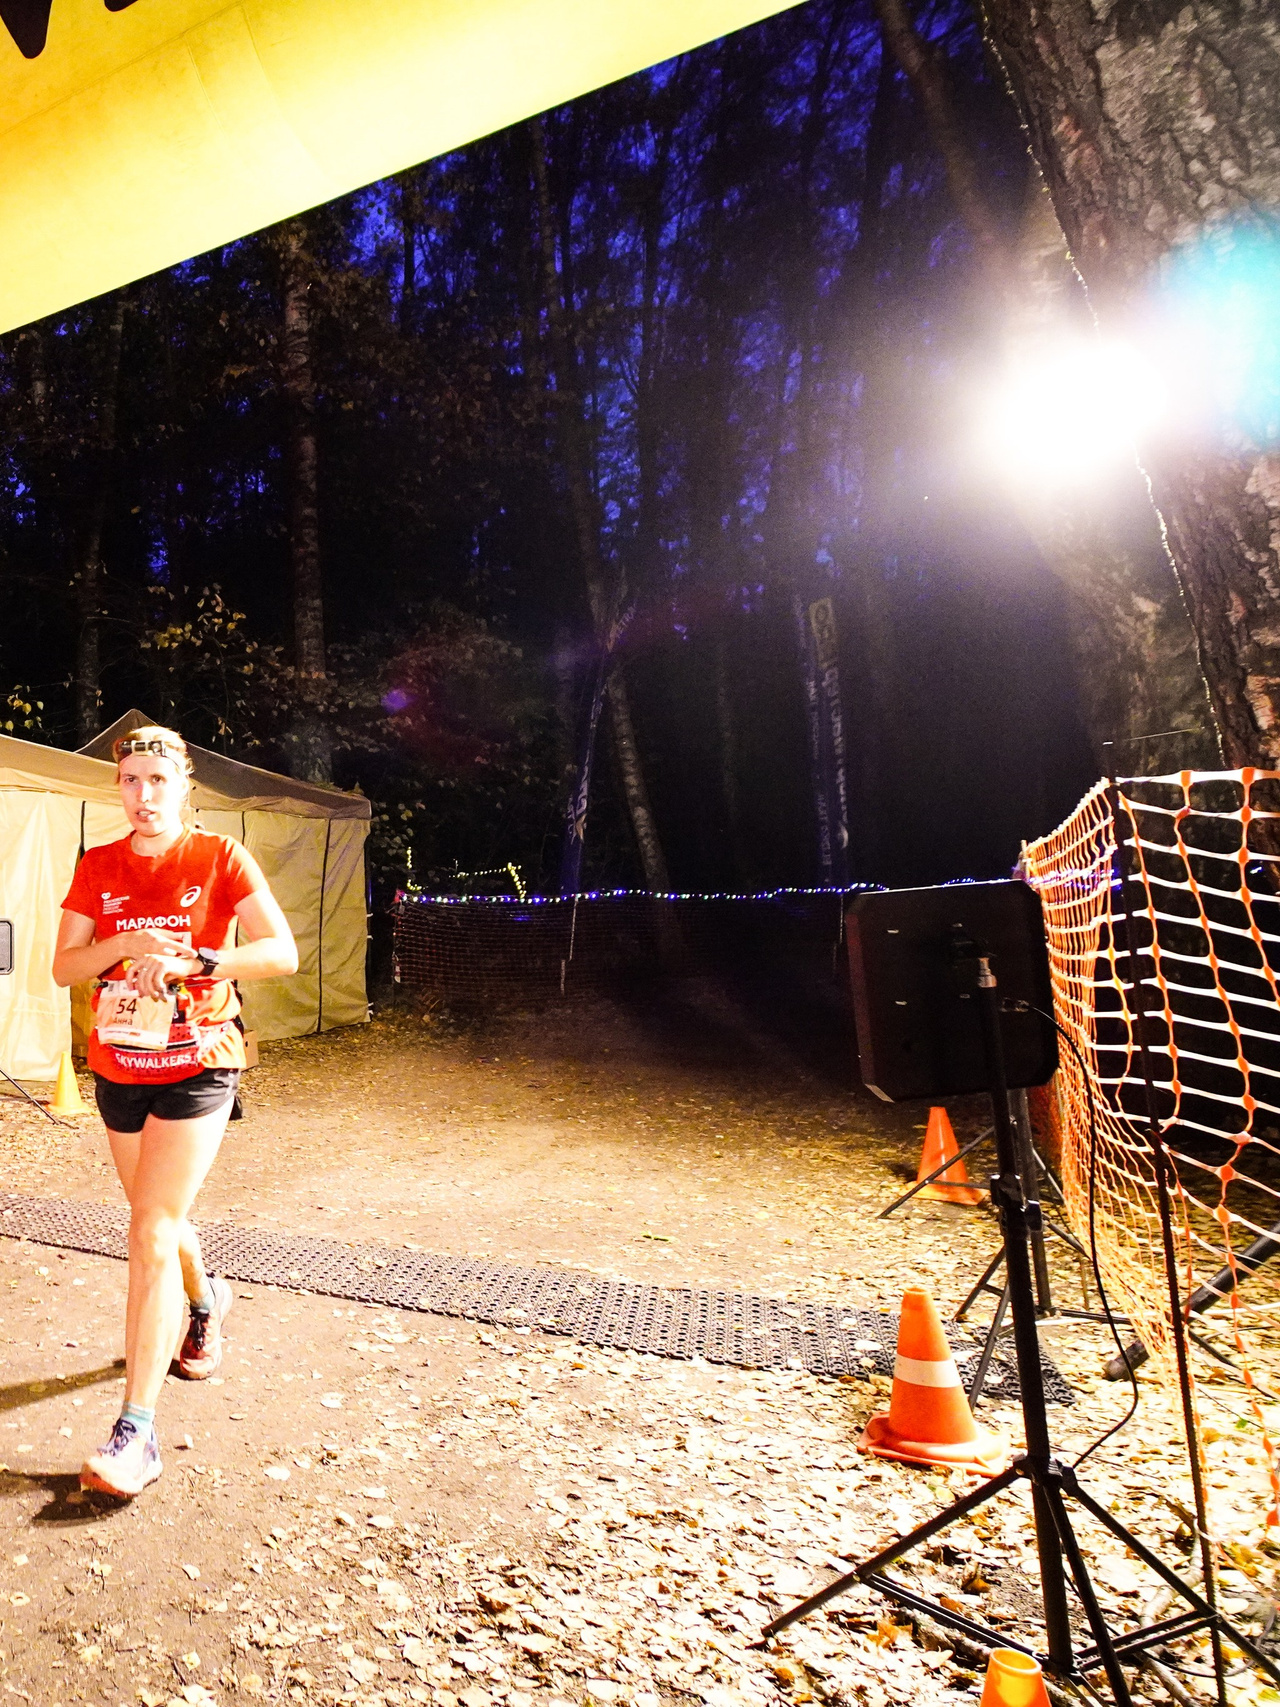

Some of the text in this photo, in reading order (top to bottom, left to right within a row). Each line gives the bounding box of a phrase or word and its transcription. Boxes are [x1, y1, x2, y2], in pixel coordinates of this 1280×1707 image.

[116, 914, 191, 931] МАРАФОН
[116, 998, 137, 1015] 54
[115, 1052, 192, 1069] SKYWALKERS
